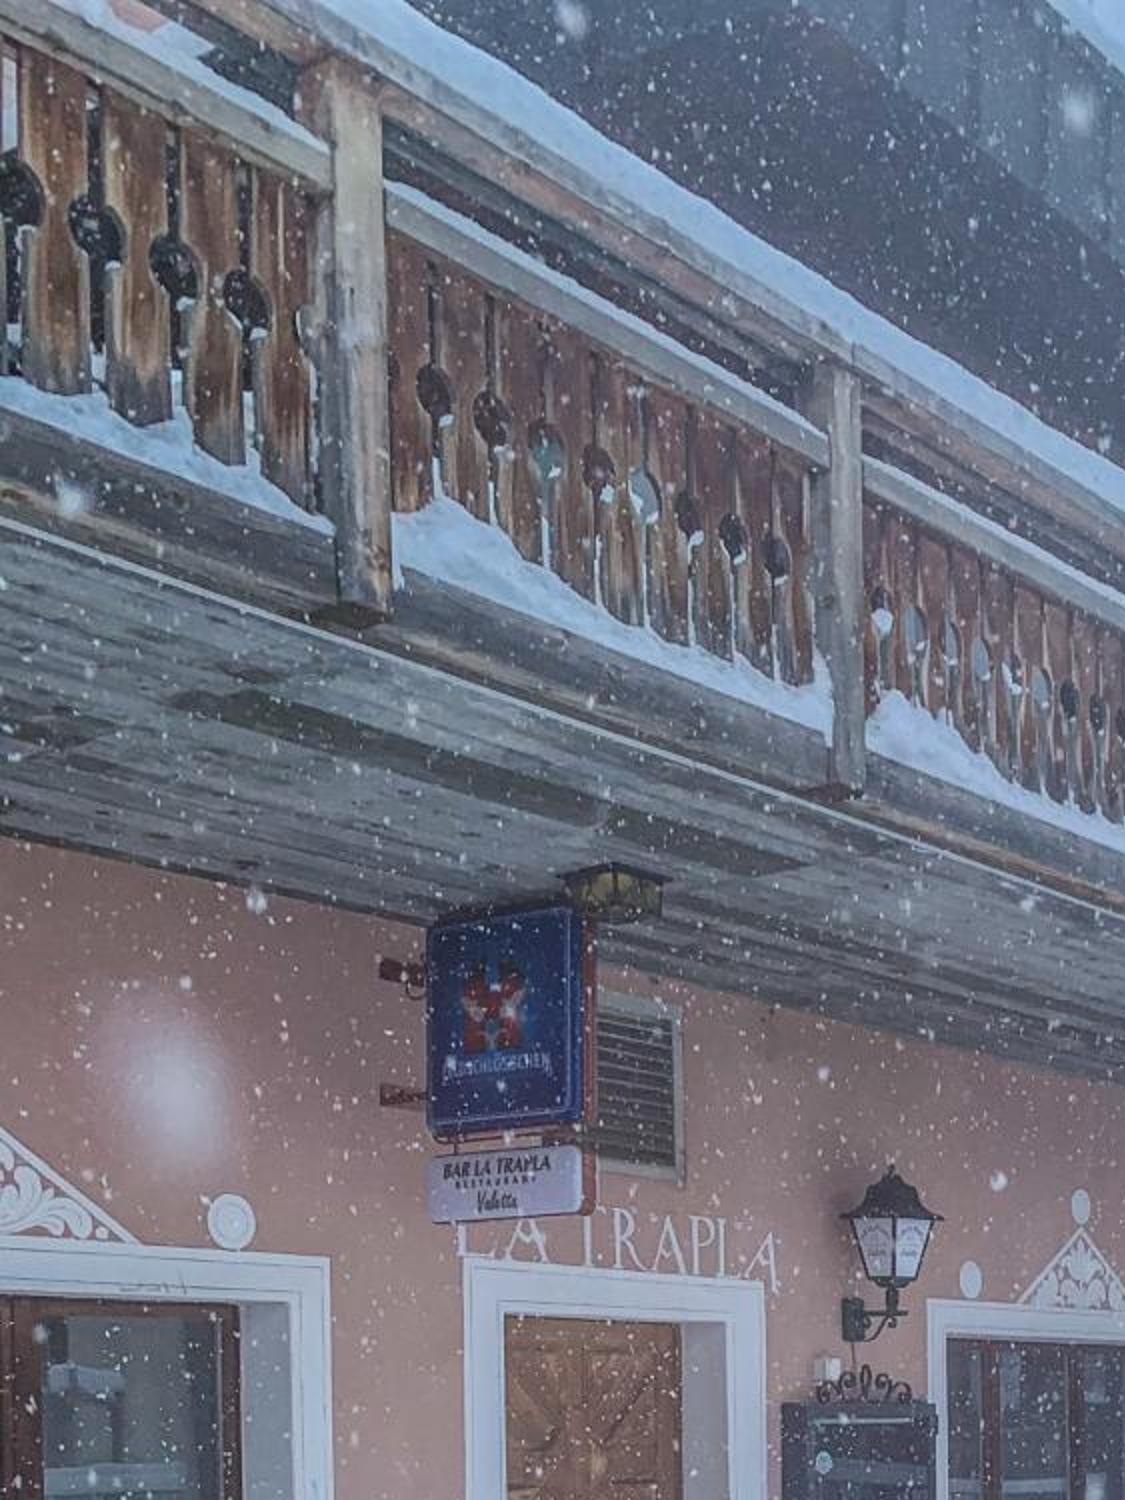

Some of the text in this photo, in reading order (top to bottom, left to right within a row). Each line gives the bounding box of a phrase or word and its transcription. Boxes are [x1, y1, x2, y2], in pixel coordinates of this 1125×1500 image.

[443, 1154, 552, 1180] BAR LA TRAPLA
